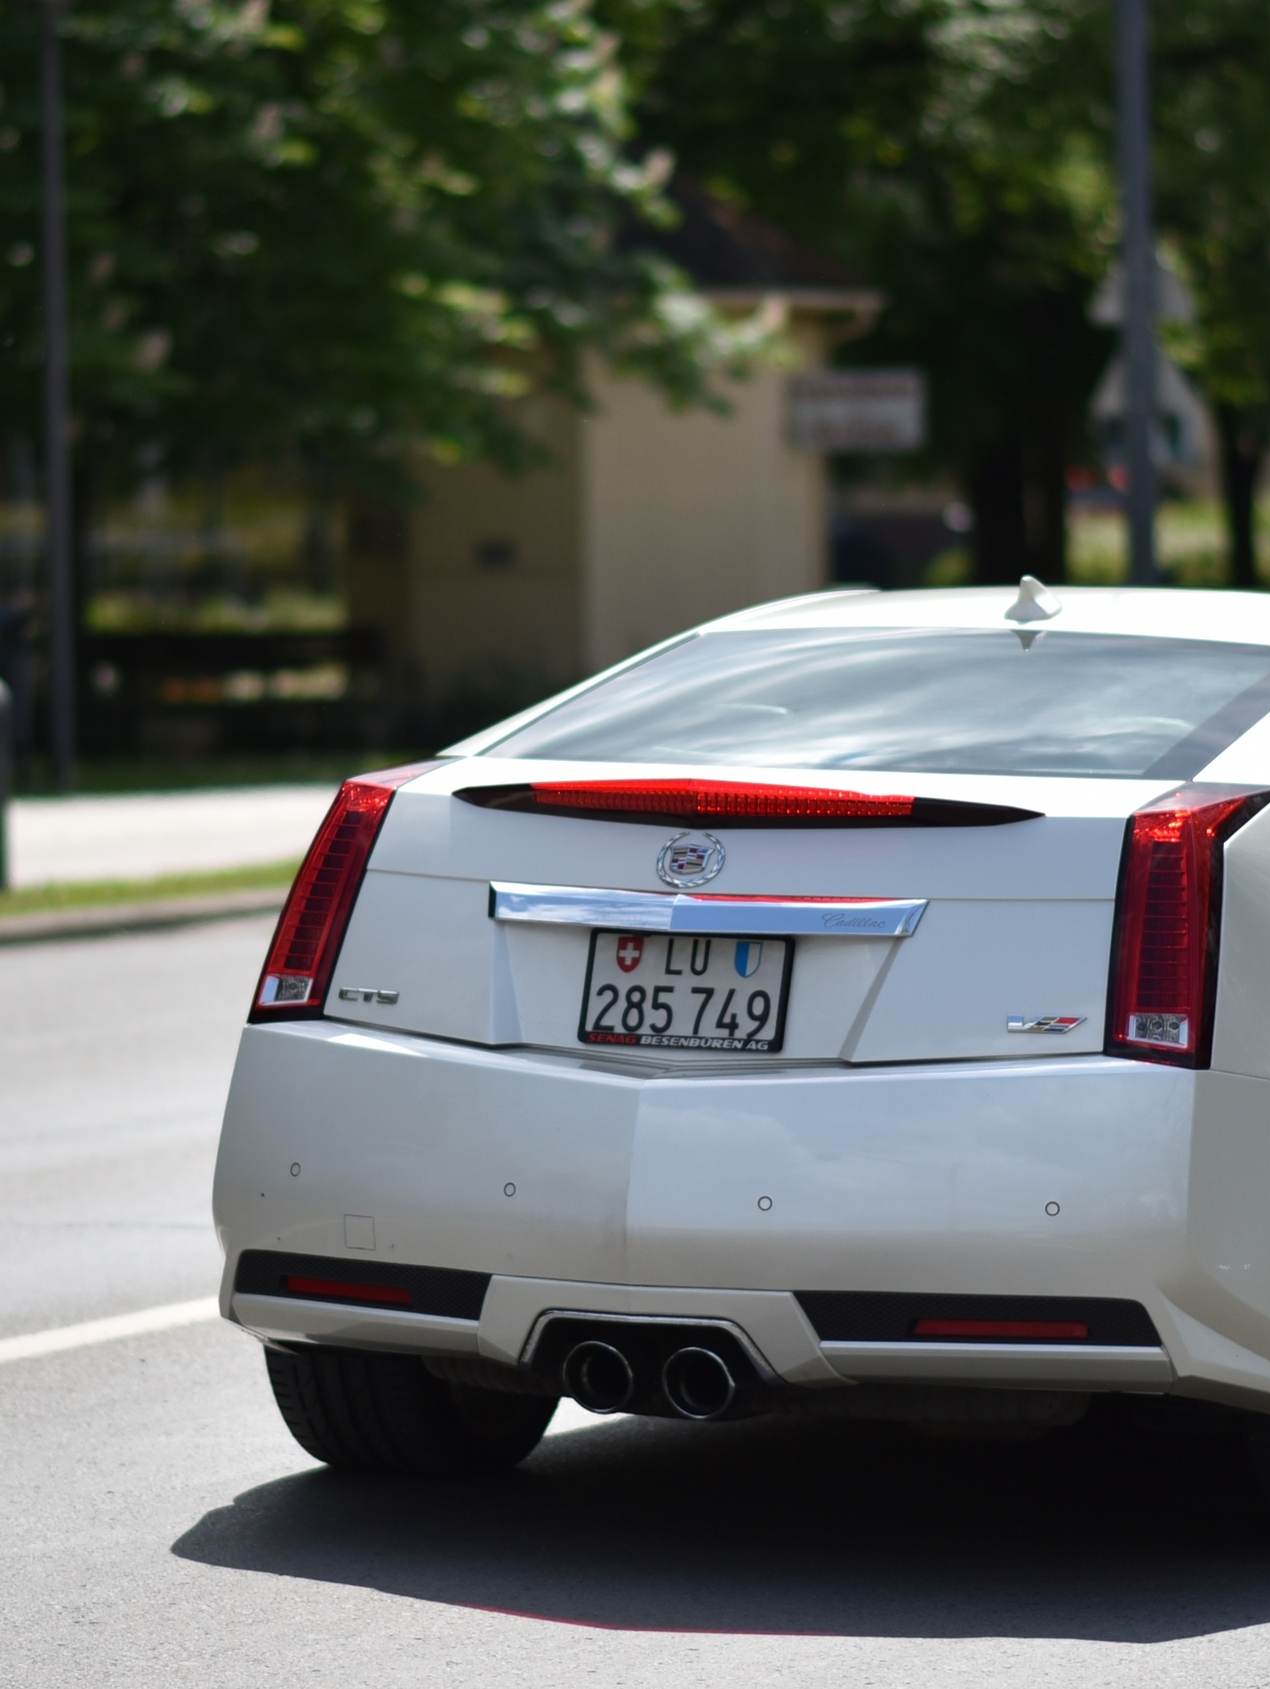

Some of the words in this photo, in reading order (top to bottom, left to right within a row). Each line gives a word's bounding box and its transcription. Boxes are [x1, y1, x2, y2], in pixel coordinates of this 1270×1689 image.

[821, 912, 886, 929] Cadillac
[664, 937, 712, 976] LU
[338, 986, 400, 1005] CTS
[592, 983, 675, 1034] 285
[690, 986, 771, 1039] 749
[587, 1032, 637, 1045] SENAG
[640, 1035, 744, 1050] BESENBÜREN
[745, 1040, 769, 1051] AG
